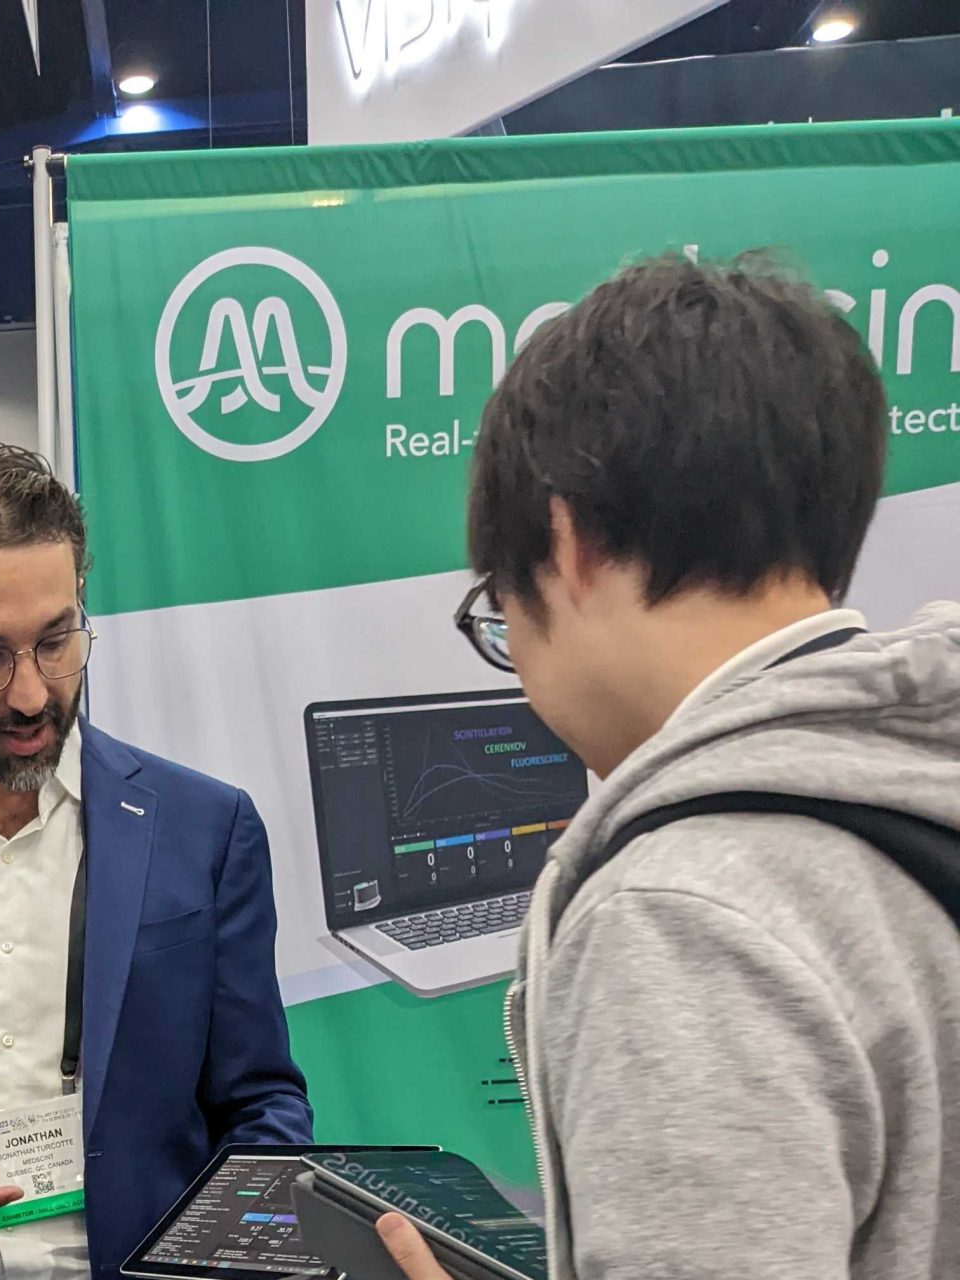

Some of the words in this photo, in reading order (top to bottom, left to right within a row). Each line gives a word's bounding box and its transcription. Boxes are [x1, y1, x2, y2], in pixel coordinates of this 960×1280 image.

[386, 419, 478, 457] Real-
[484, 741, 526, 754] CERENKOV
[427, 853, 435, 866] 0
[467, 847, 474, 859] 0
[504, 840, 511, 853] 0
[5, 1128, 63, 1149] JONATHAN
[0, 1147, 35, 1161] JONATHAN
[37, 1139, 75, 1152] TURCOTTE
[22, 1154, 54, 1165] MEDSCINT
[48, 1159, 74, 1169] CANADA
